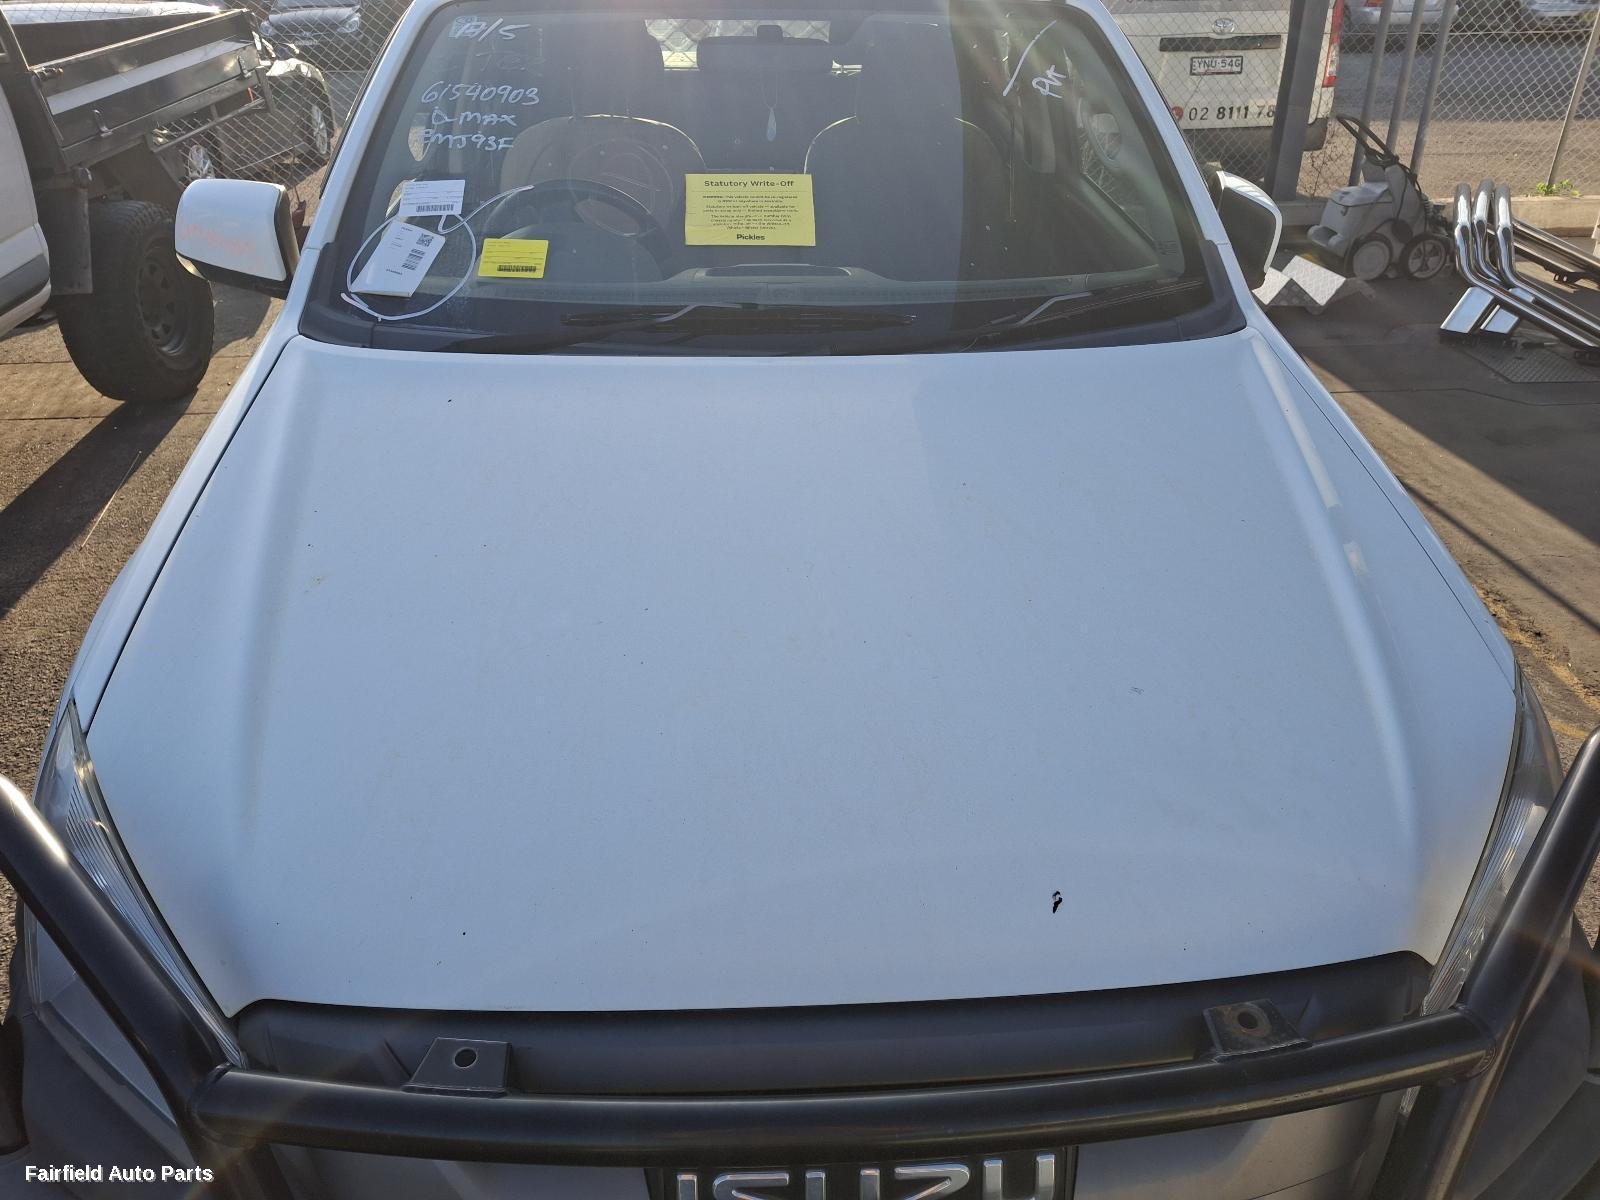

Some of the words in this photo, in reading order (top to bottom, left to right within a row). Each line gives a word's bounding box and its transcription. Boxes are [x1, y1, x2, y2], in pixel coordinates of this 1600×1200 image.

[421, 80, 540, 105] 61540903
[1189, 107, 1209, 121] 02
[1216, 105, 1249, 120] 8111
[704, 180, 748, 188] Statutory
[736, 233, 766, 241] Pickles
